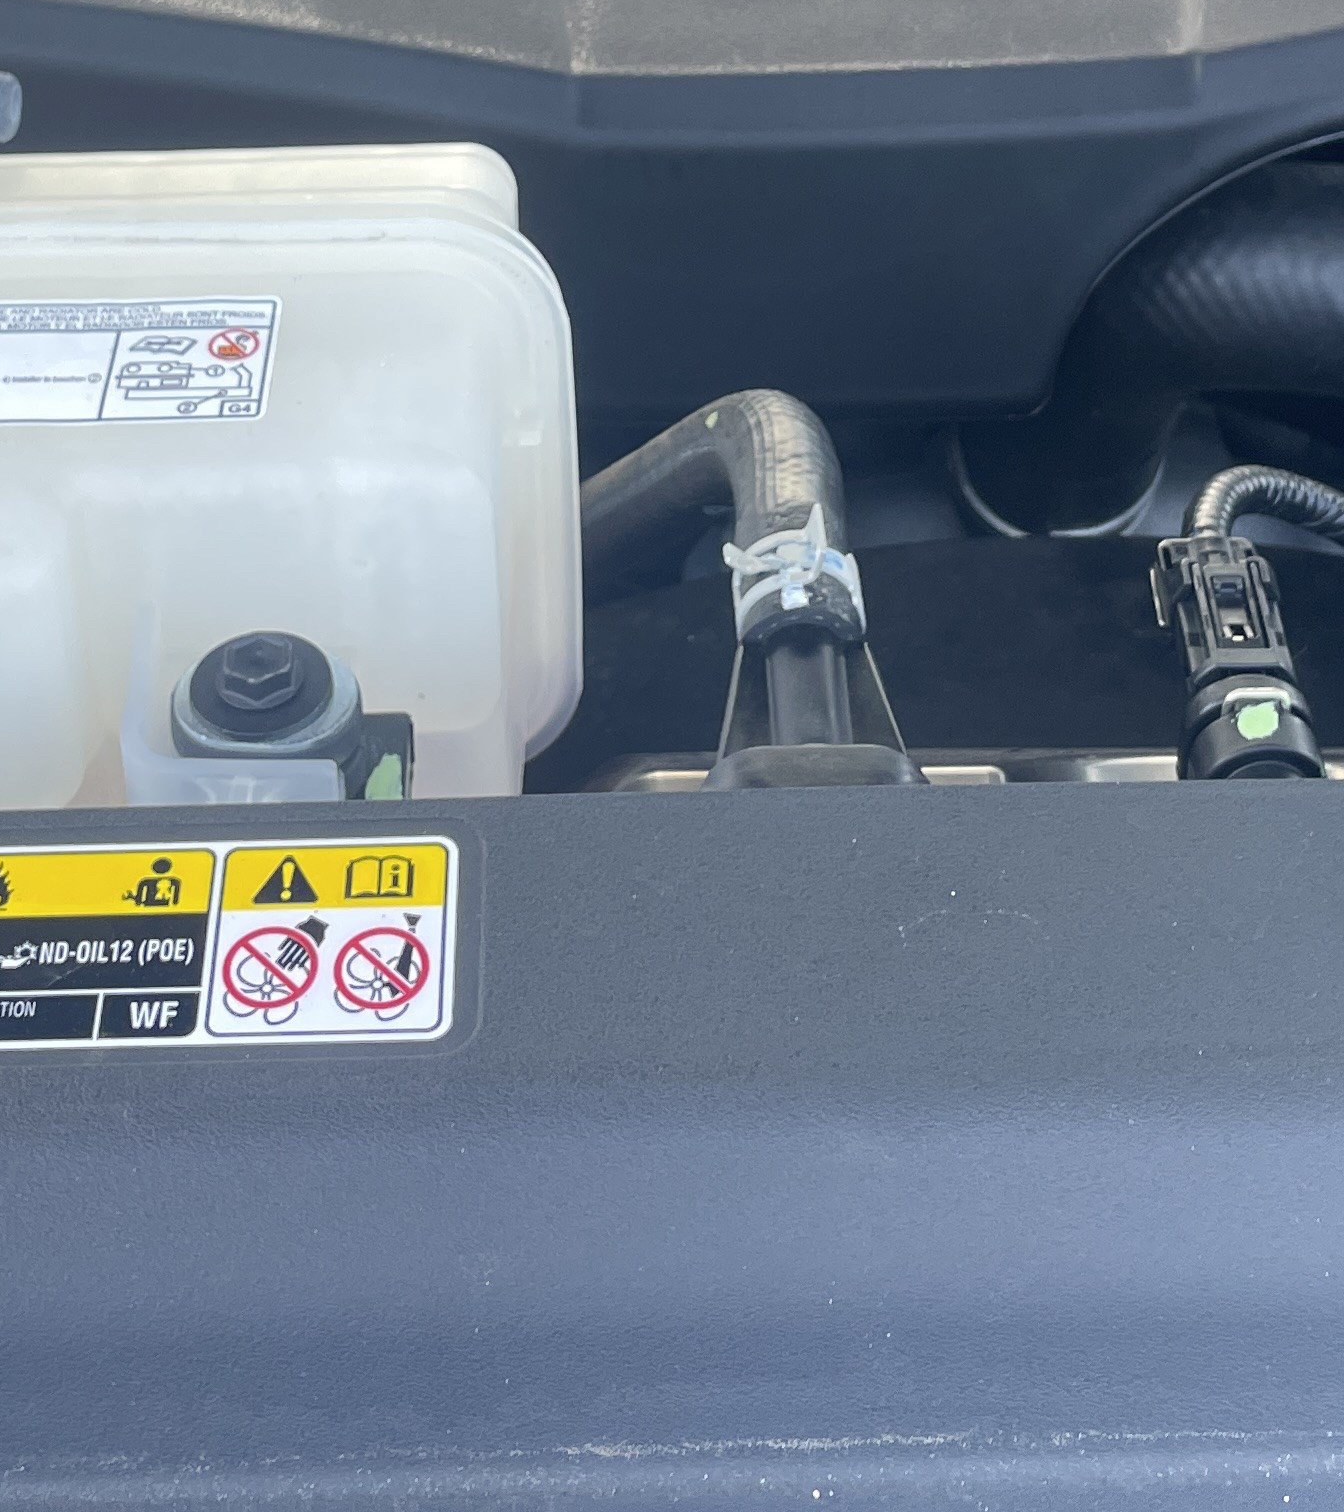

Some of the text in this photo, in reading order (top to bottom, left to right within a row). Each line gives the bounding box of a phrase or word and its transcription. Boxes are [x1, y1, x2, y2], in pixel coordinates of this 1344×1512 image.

[228, 403, 252, 414] G4
[38, 939, 135, 965] ND-OIL12
[137, 937, 195, 967] (POE)
[129, 999, 180, 1030] WF
